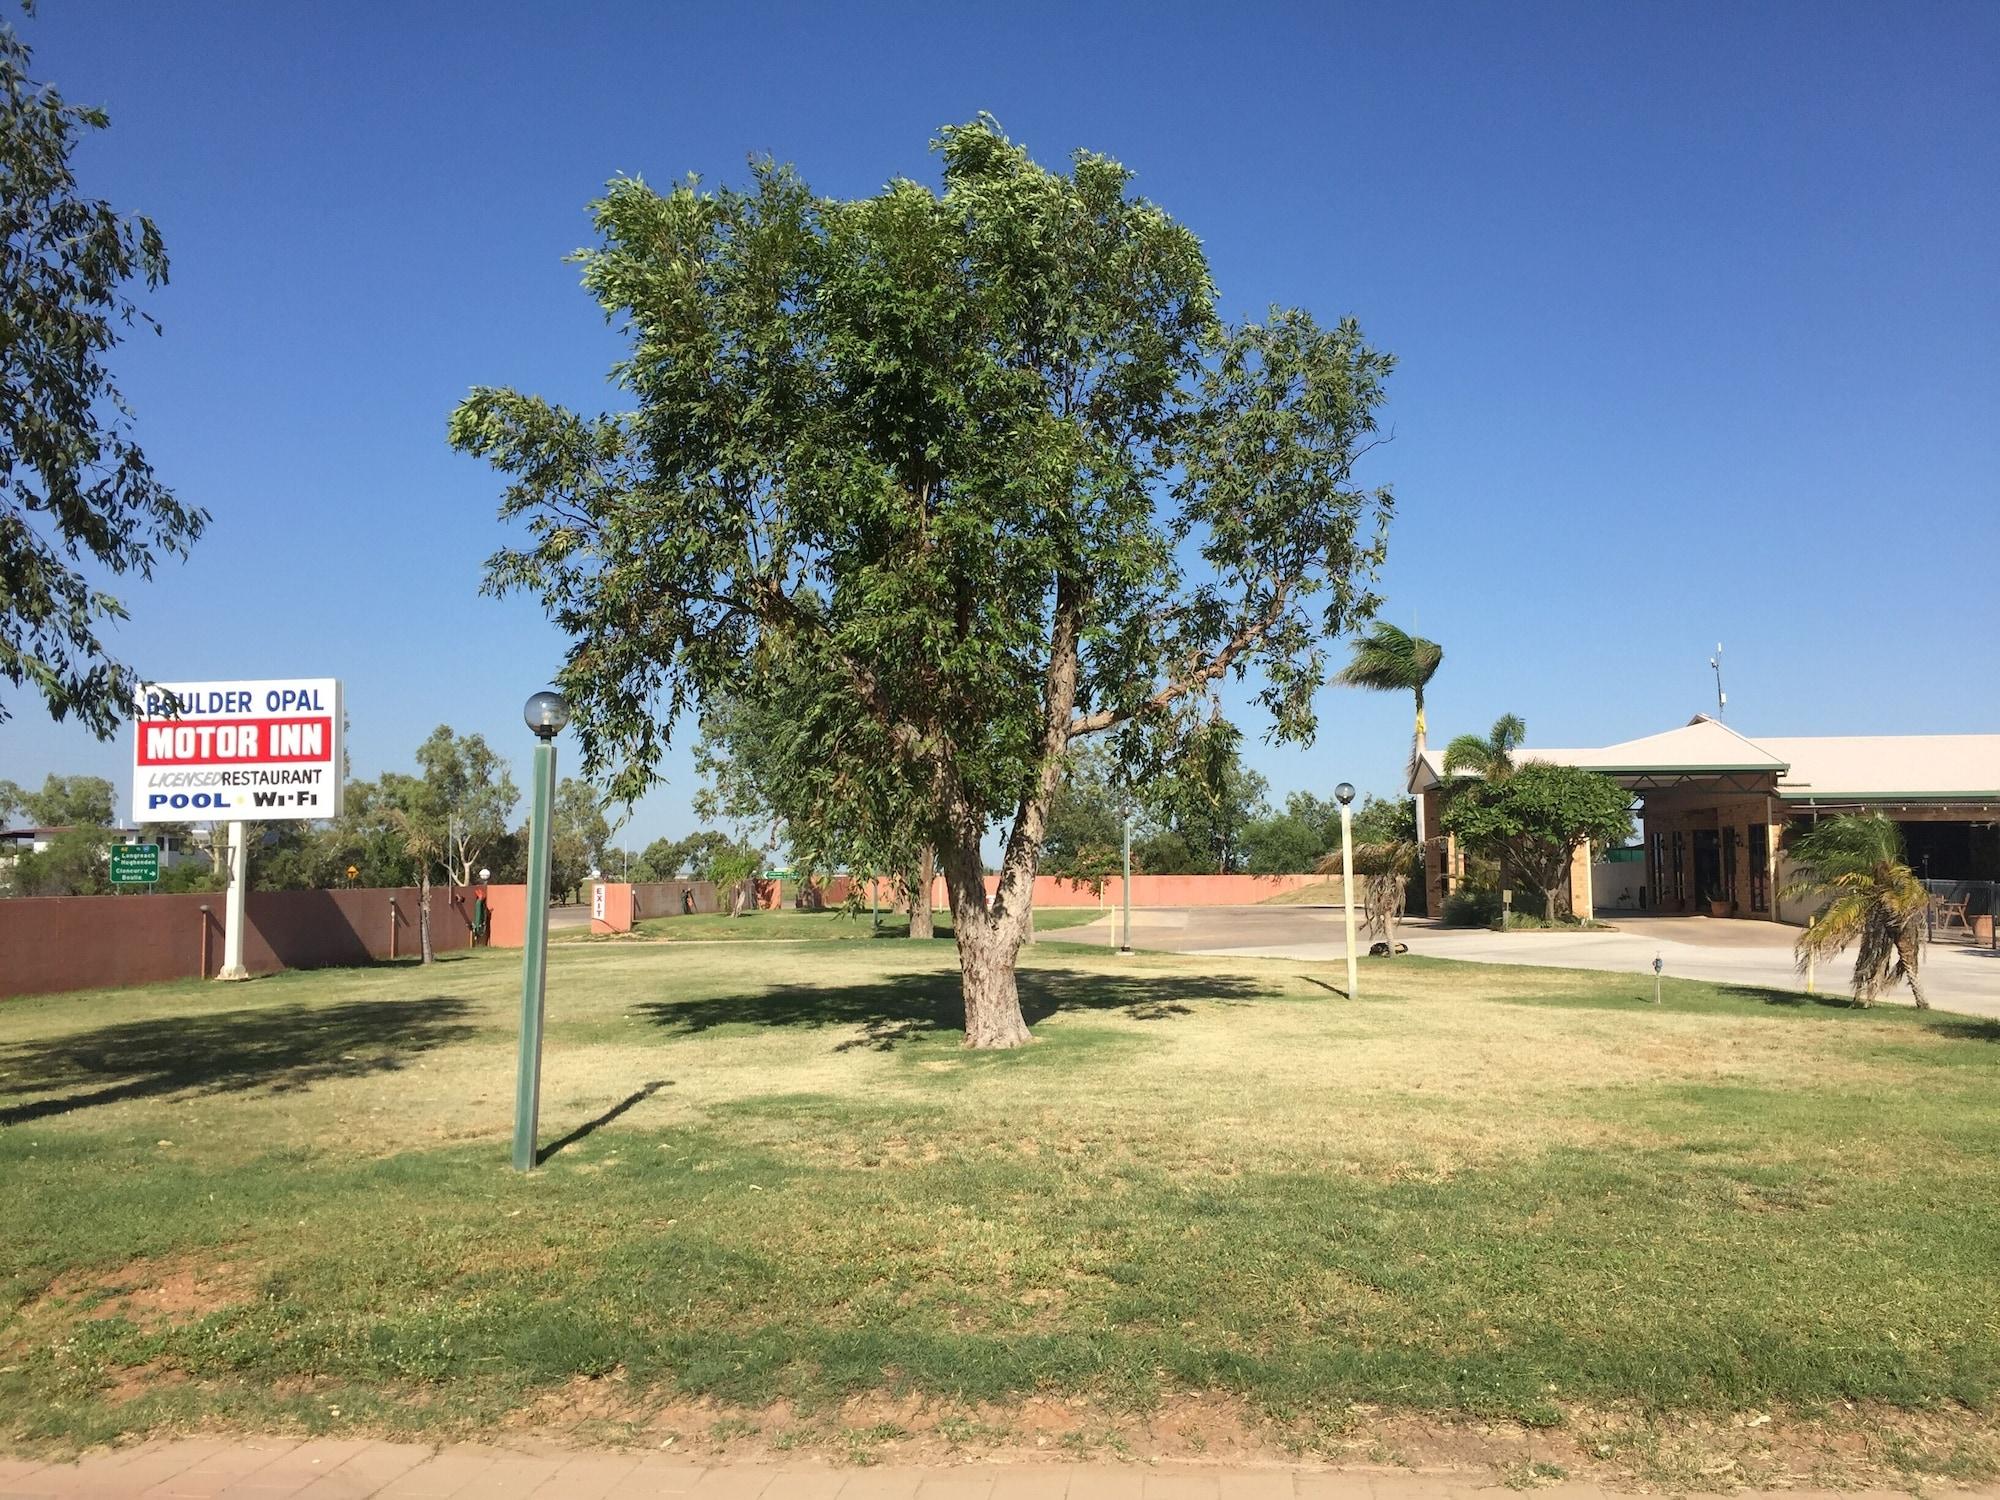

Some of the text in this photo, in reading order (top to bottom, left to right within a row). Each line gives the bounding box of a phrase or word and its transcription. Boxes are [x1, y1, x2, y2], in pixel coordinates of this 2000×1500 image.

[266, 689, 325, 713] OPAL
[146, 723, 322, 760] MOTOR INN
[148, 769, 322, 788] LICENSED RESTAURANT
[149, 793, 231, 810] POOL
